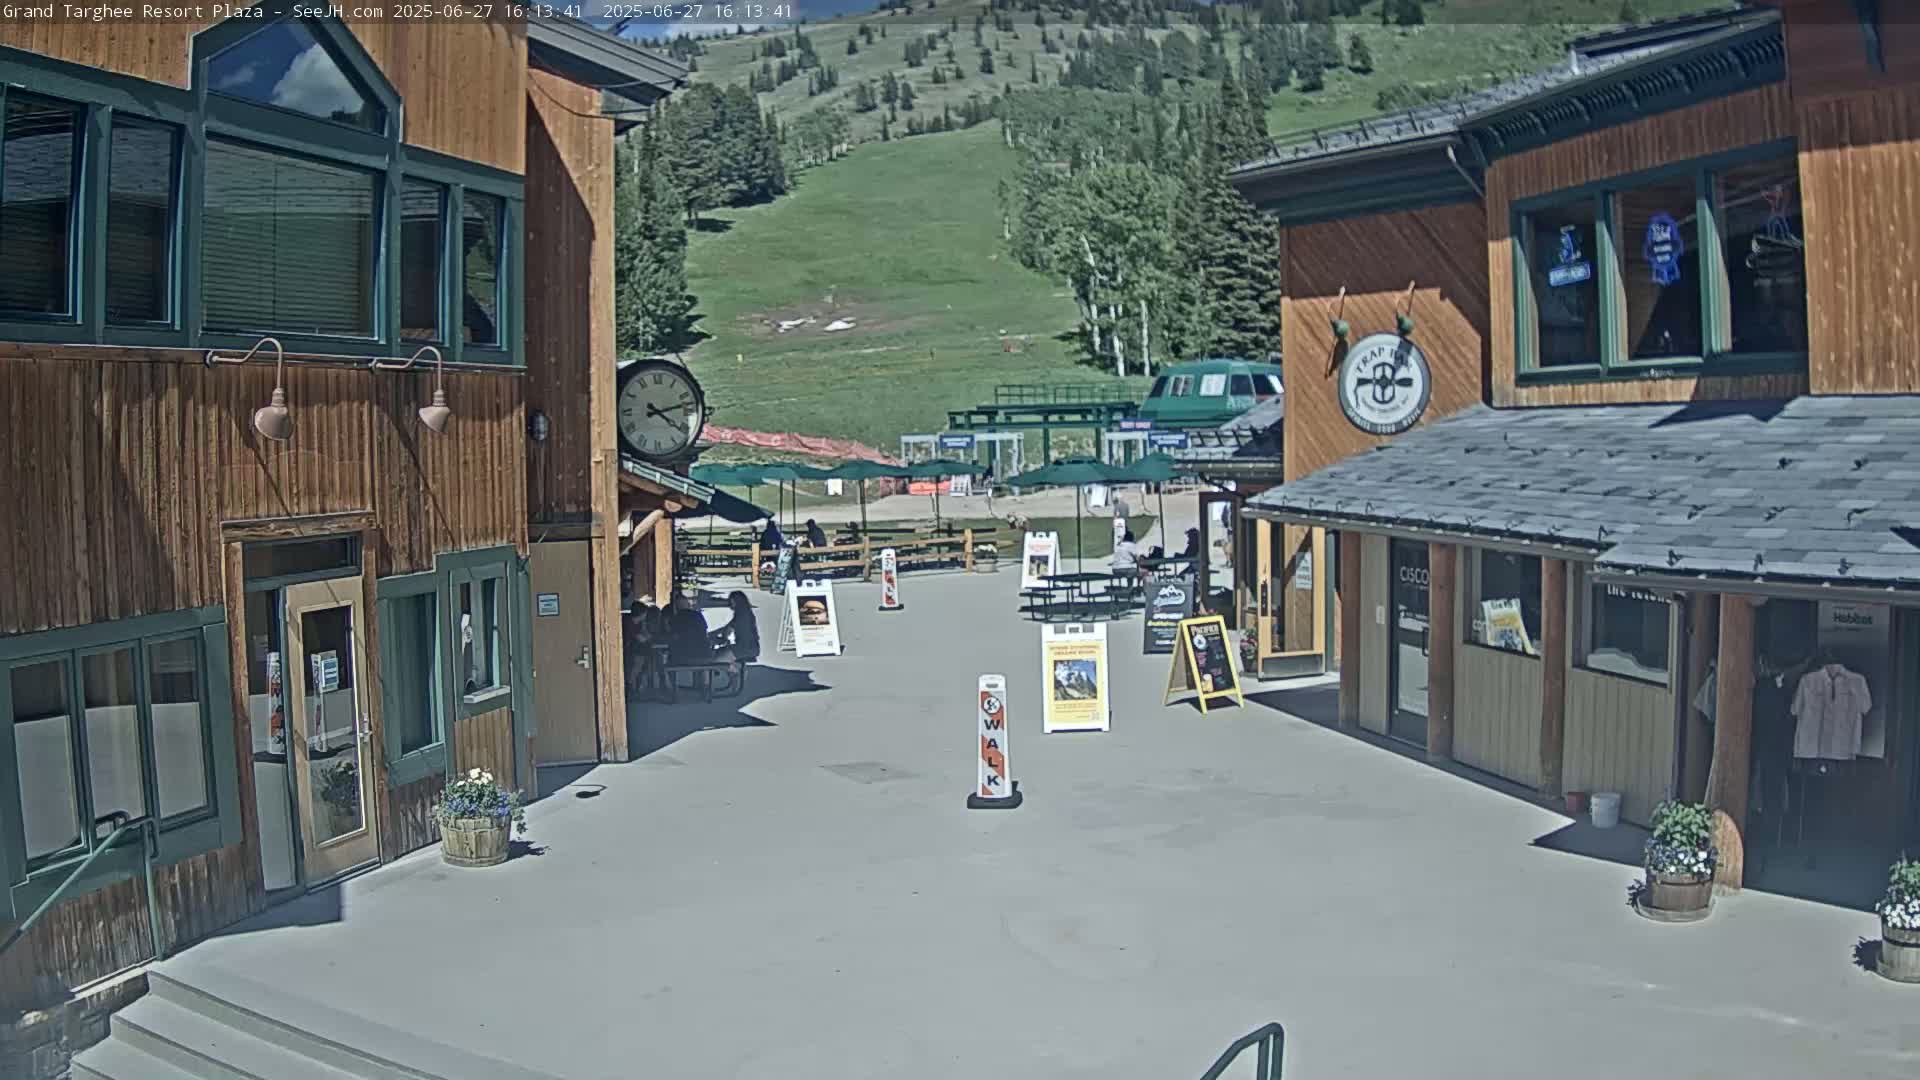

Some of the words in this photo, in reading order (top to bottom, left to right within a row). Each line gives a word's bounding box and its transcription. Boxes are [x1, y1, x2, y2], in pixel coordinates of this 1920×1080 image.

[1355, 346, 1385, 373] TRAP
[1400, 565, 1430, 584] CISCO
[984, 718, 1000, 786] WALK
